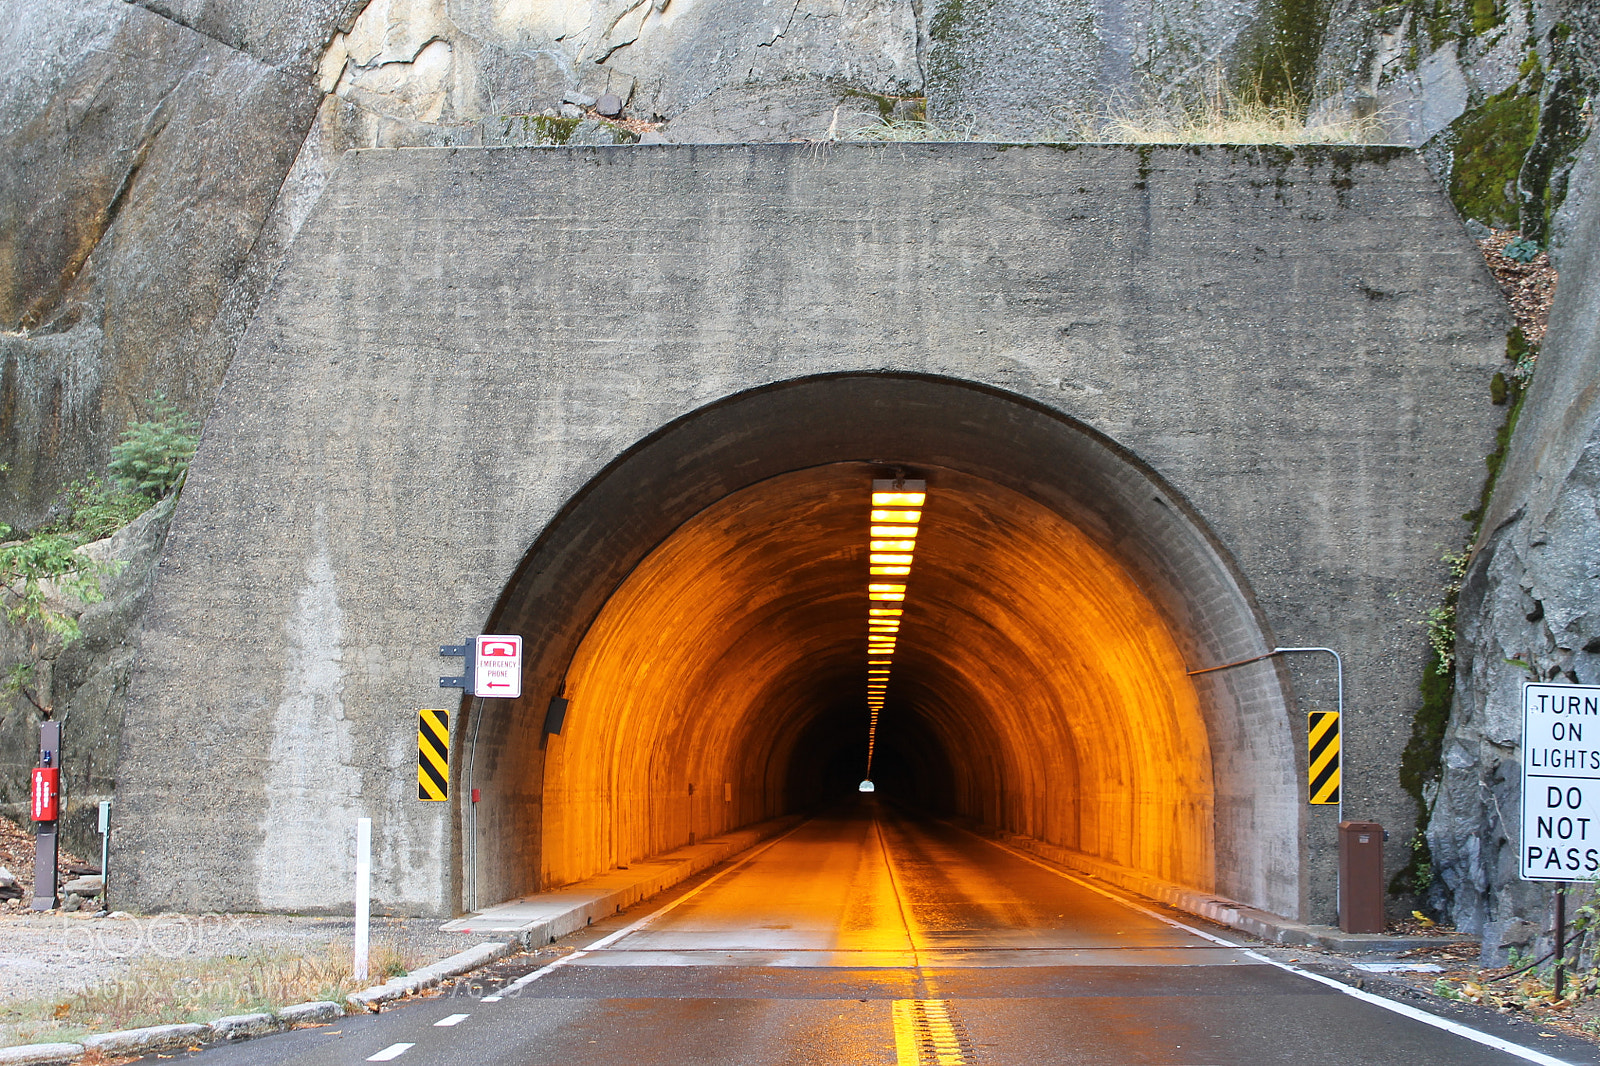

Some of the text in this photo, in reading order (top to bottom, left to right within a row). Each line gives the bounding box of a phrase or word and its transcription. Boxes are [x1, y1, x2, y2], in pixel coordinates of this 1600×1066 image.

[480, 660, 516, 668] EMERGENCY
[487, 670, 508, 678] PHONE
[1537, 694, 1598, 715] TURN
[1552, 721, 1582, 742] ON
[1531, 748, 1600, 770] LIGHTS
[1547, 786, 1582, 810] DO
[1537, 816, 1591, 840] NOT
[1527, 846, 1599, 872] PASS
